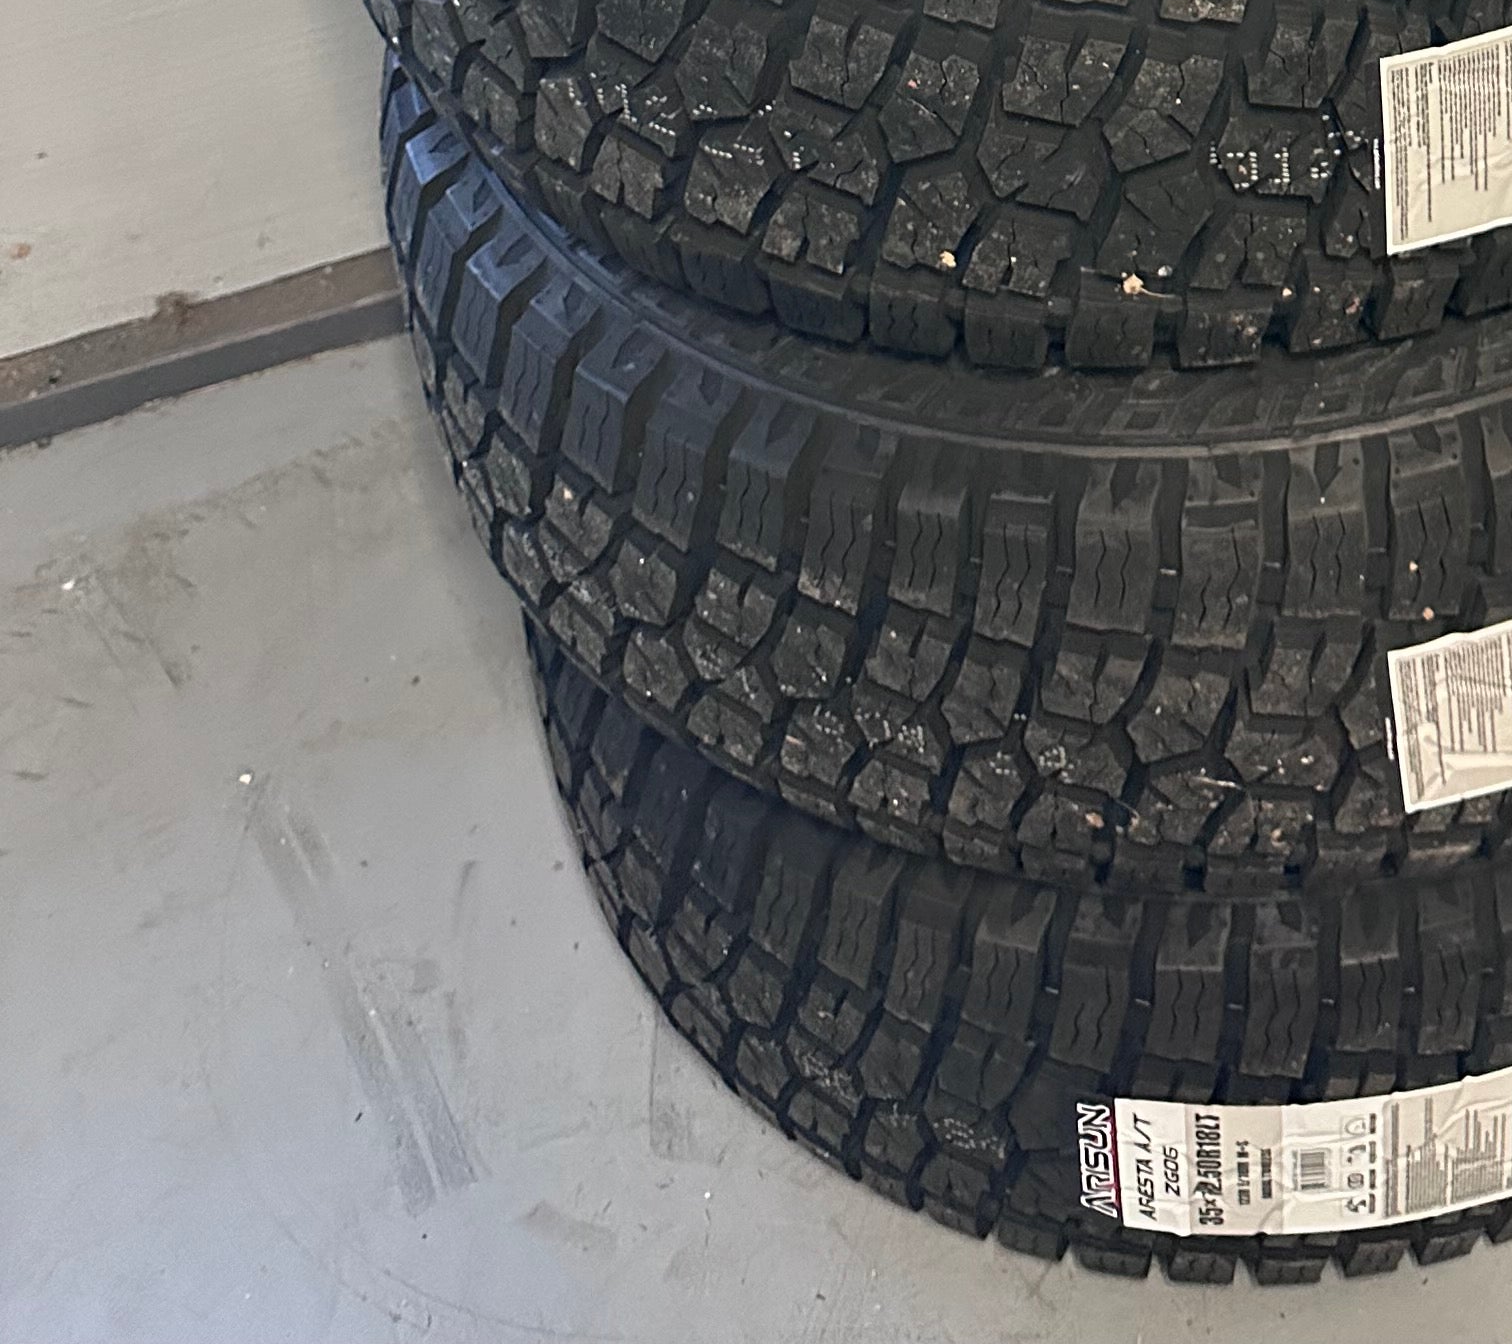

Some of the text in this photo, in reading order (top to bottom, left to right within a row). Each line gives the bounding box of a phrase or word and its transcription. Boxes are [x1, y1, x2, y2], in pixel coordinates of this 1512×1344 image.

[1076, 1102, 1118, 1218] ARISUN
[1132, 1112, 1158, 1221] ARESTA A/T
[1162, 1146, 1181, 1197] ZG06
